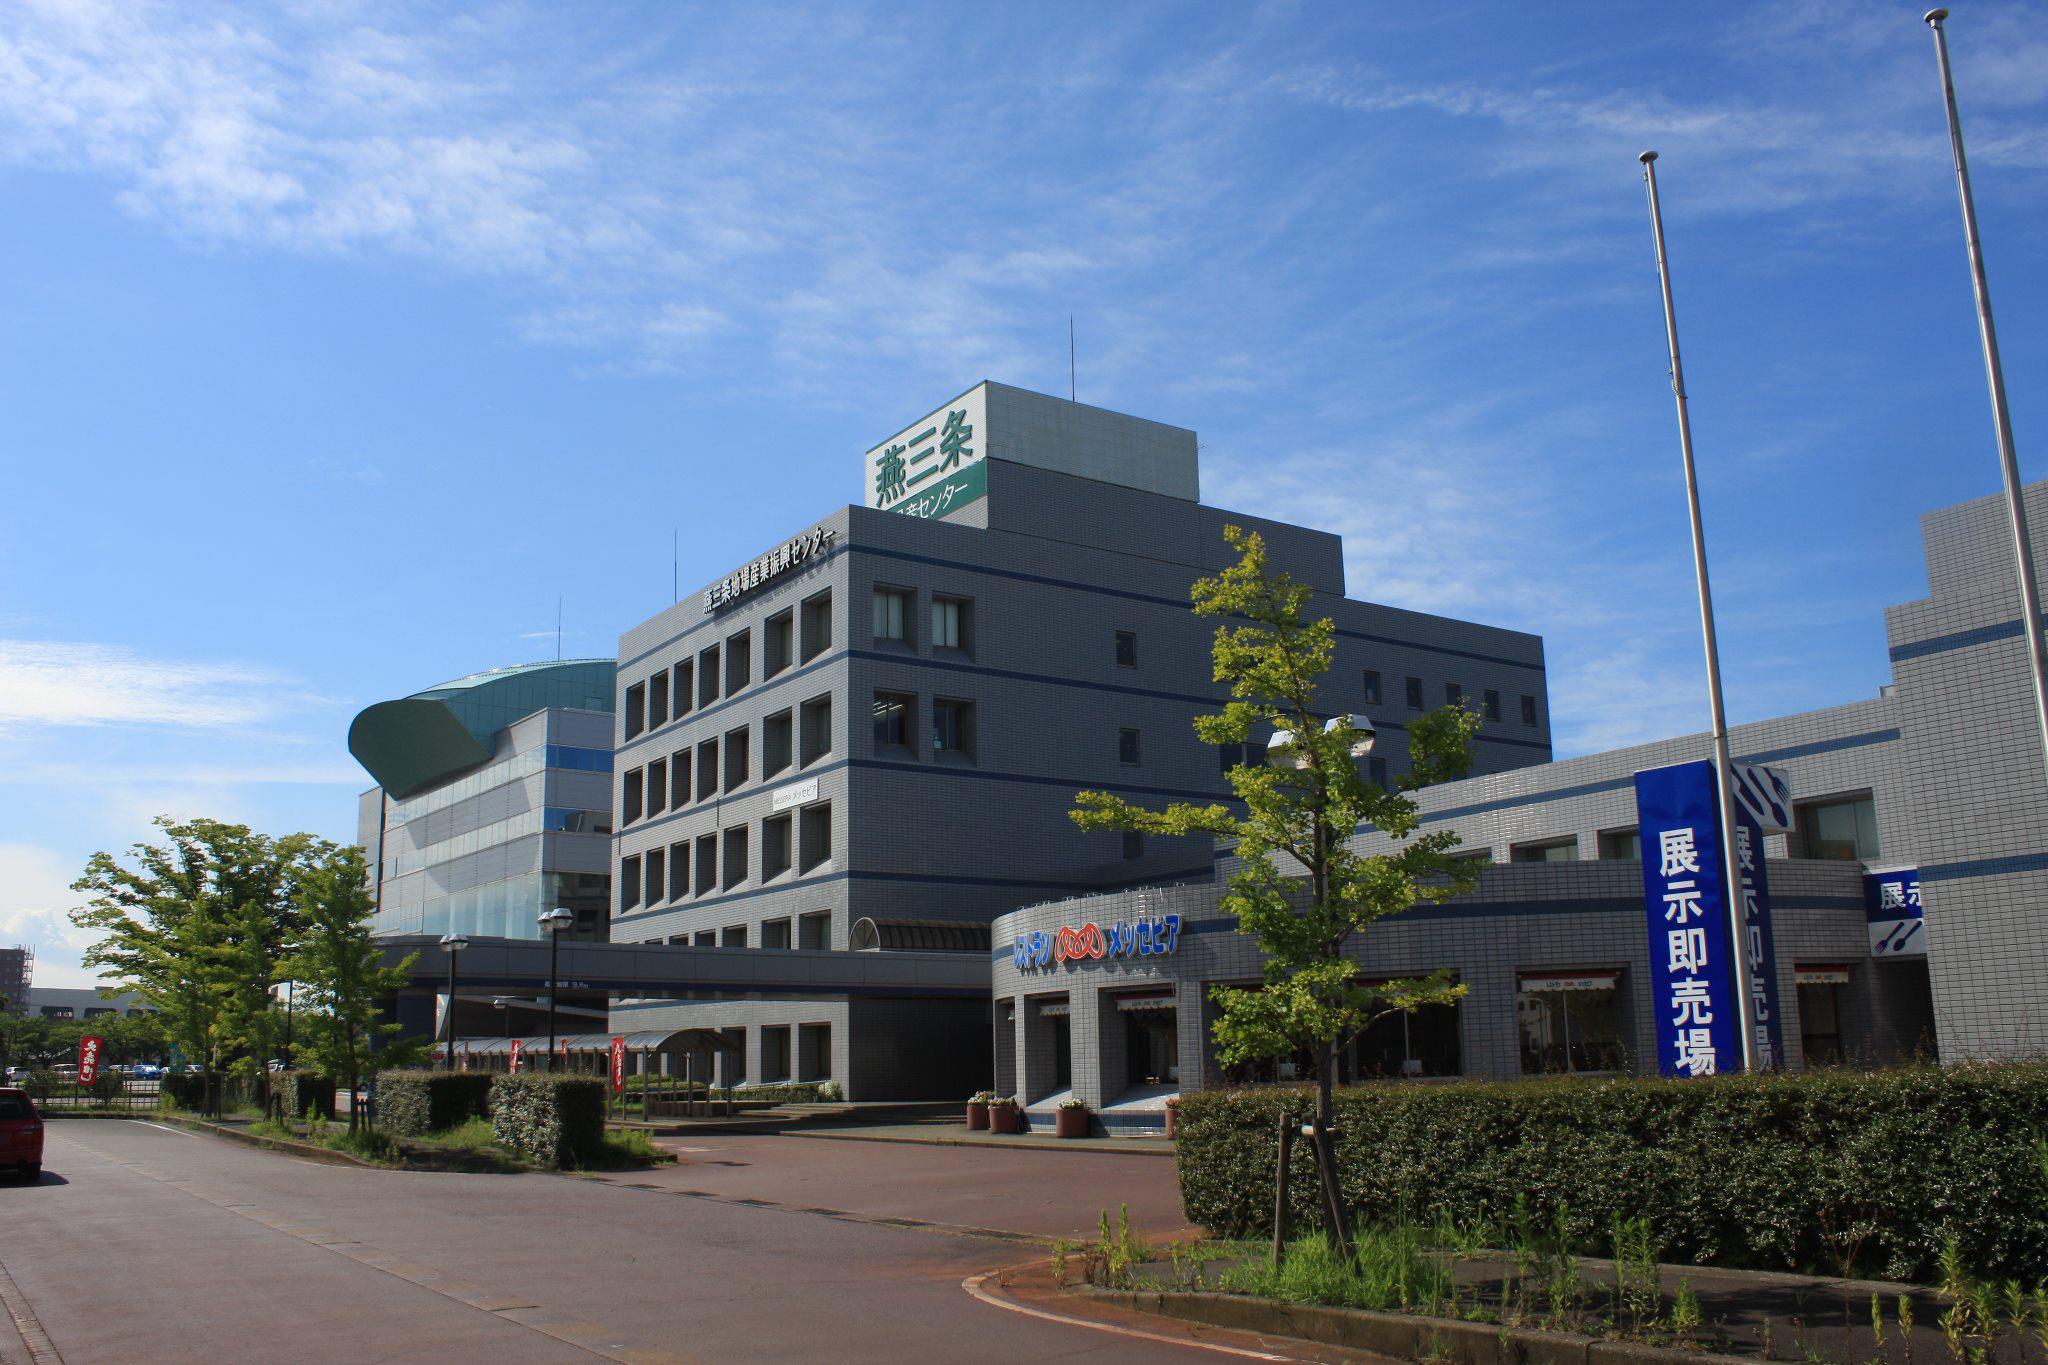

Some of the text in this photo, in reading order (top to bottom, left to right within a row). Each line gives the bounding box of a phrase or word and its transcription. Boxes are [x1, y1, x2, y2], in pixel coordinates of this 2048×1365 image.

[875, 408, 973, 509] 燕三条
[1014, 913, 1180, 970] レストラン メッセピア
[1659, 827, 1717, 1077] 展示即売場
